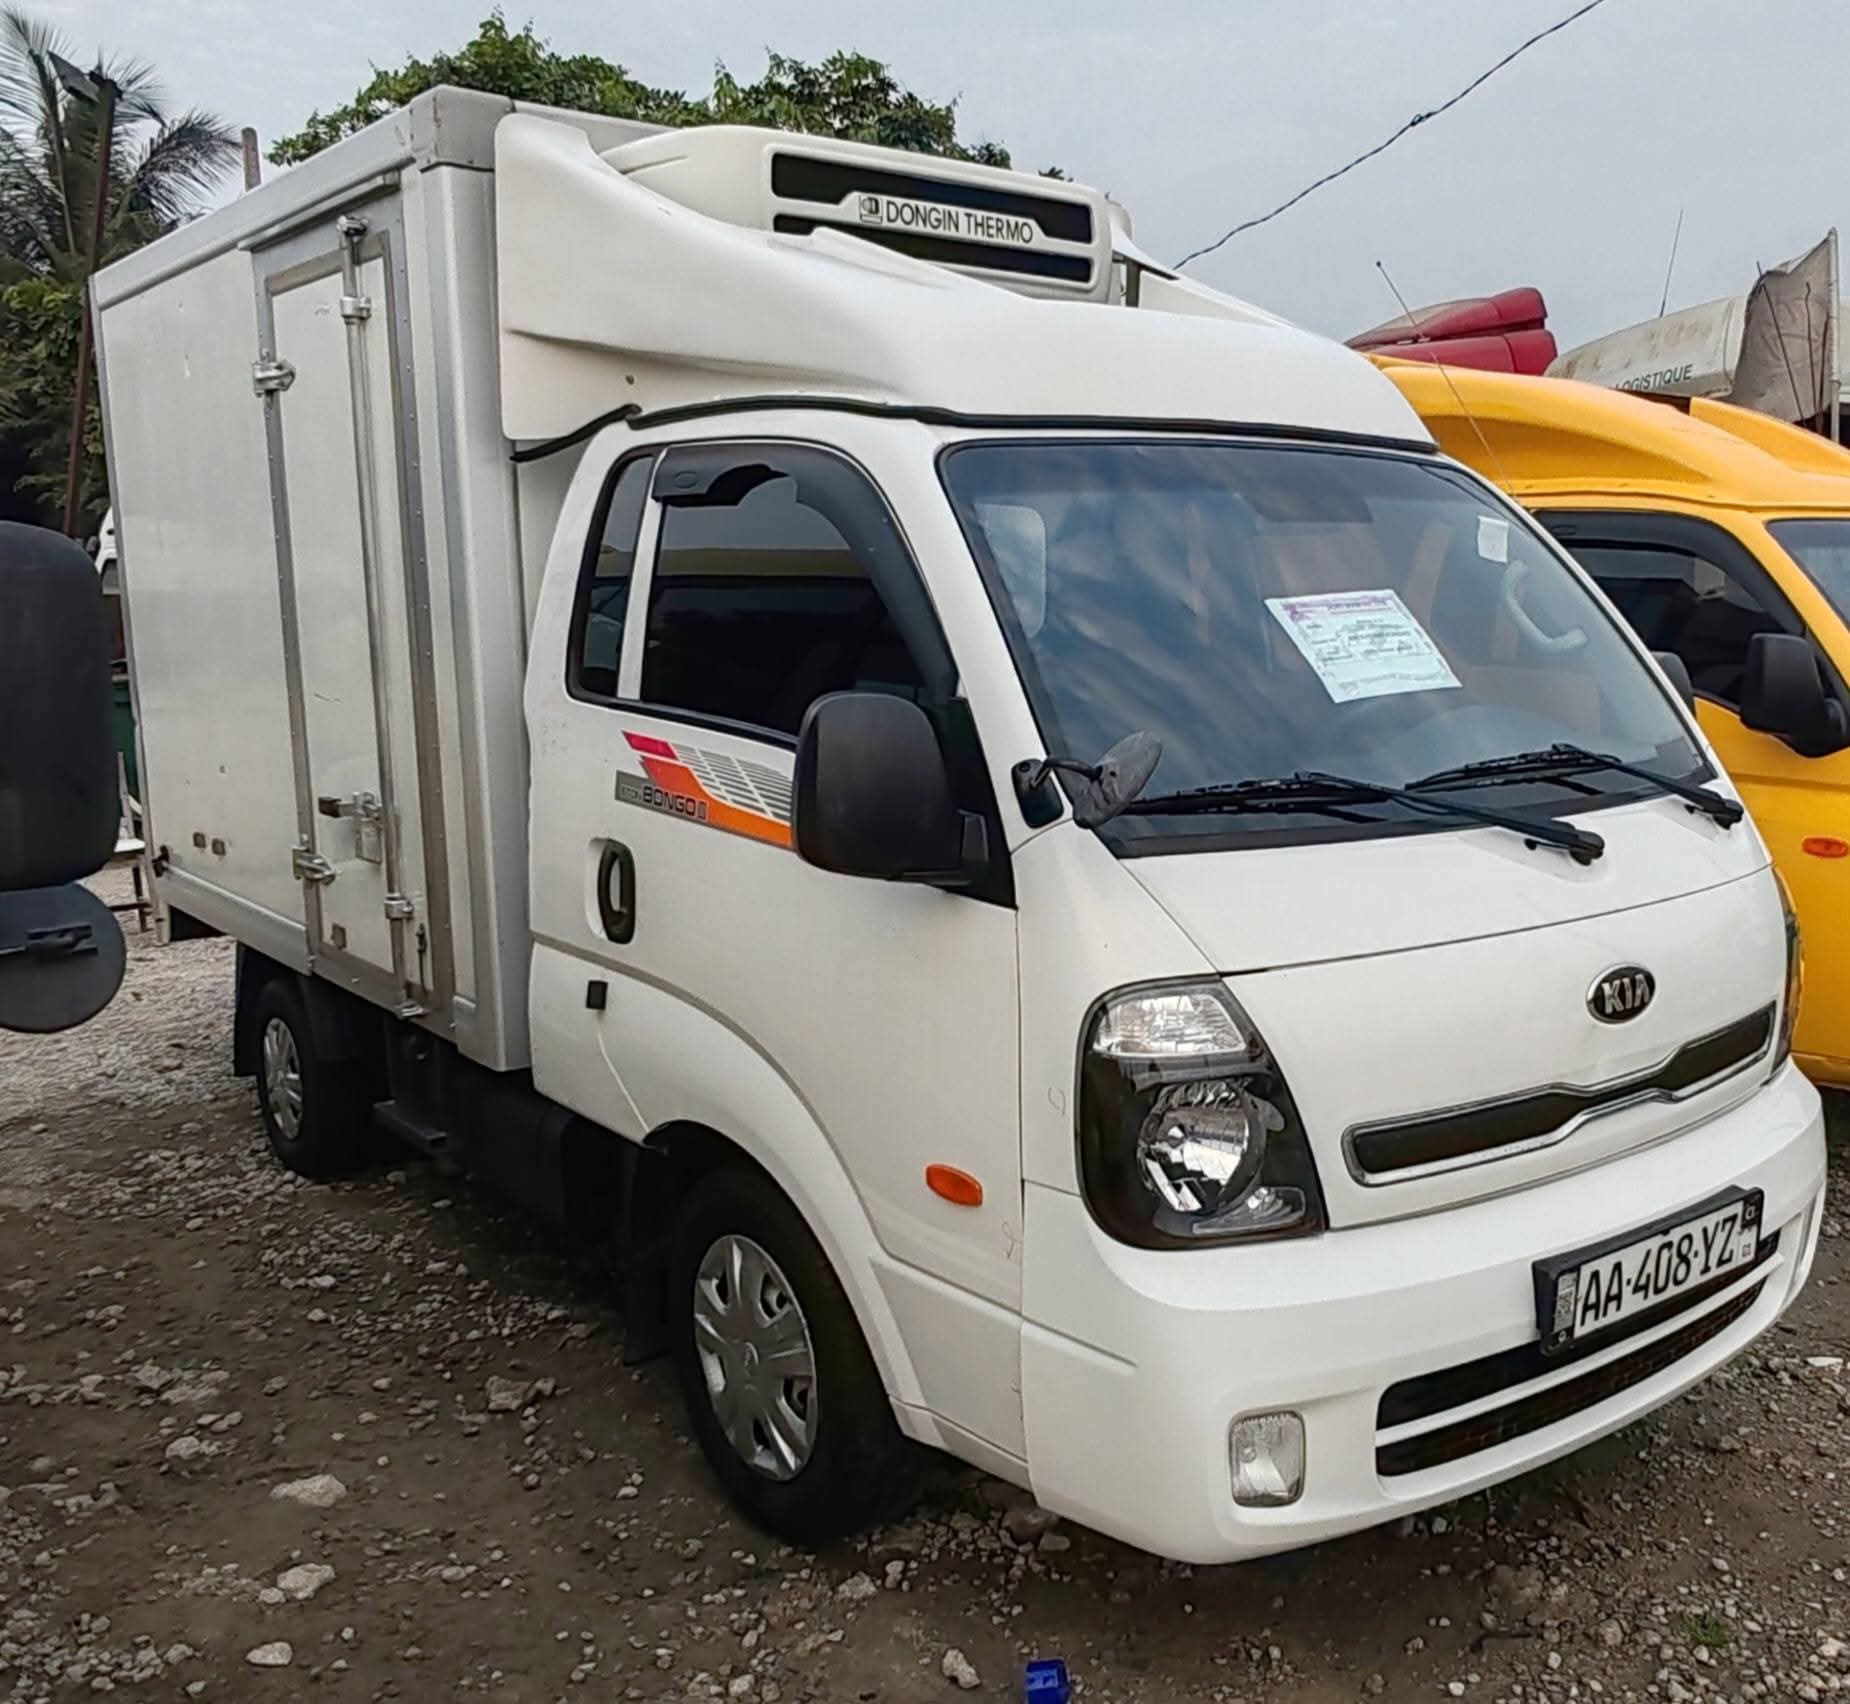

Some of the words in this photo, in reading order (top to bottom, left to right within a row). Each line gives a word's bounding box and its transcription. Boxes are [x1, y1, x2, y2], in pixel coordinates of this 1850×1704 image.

[886, 199, 960, 234] DONGIN
[964, 211, 1034, 245] THERMO
[643, 785, 696, 816] BONGO
[1600, 973, 1651, 1015] KIA
